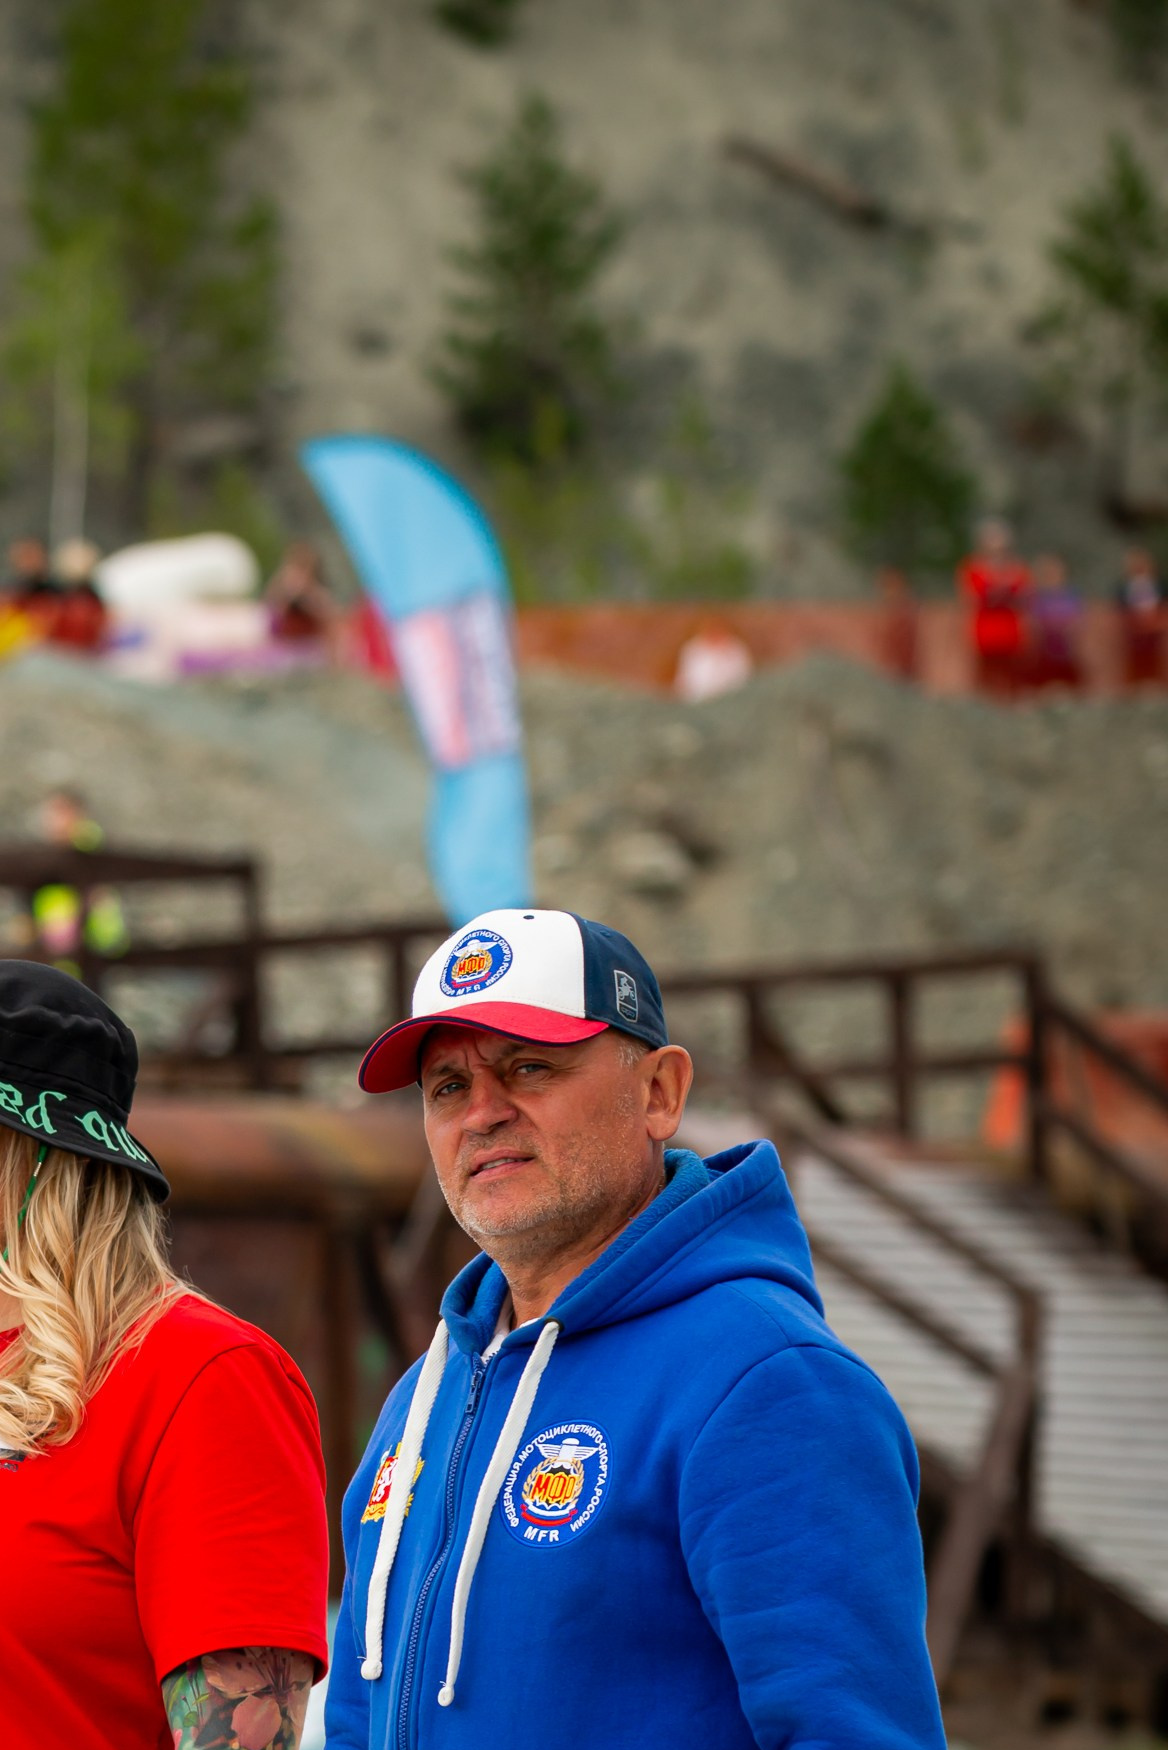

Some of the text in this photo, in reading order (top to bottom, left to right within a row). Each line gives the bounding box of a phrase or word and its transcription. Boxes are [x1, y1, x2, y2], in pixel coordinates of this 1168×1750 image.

[503, 1424, 608, 1532] ФЕДЕРАЦИЯ МОТОЦИКЛЕТНОГО СПОРТА РОССИИ
[523, 1525, 560, 1542] MFR
